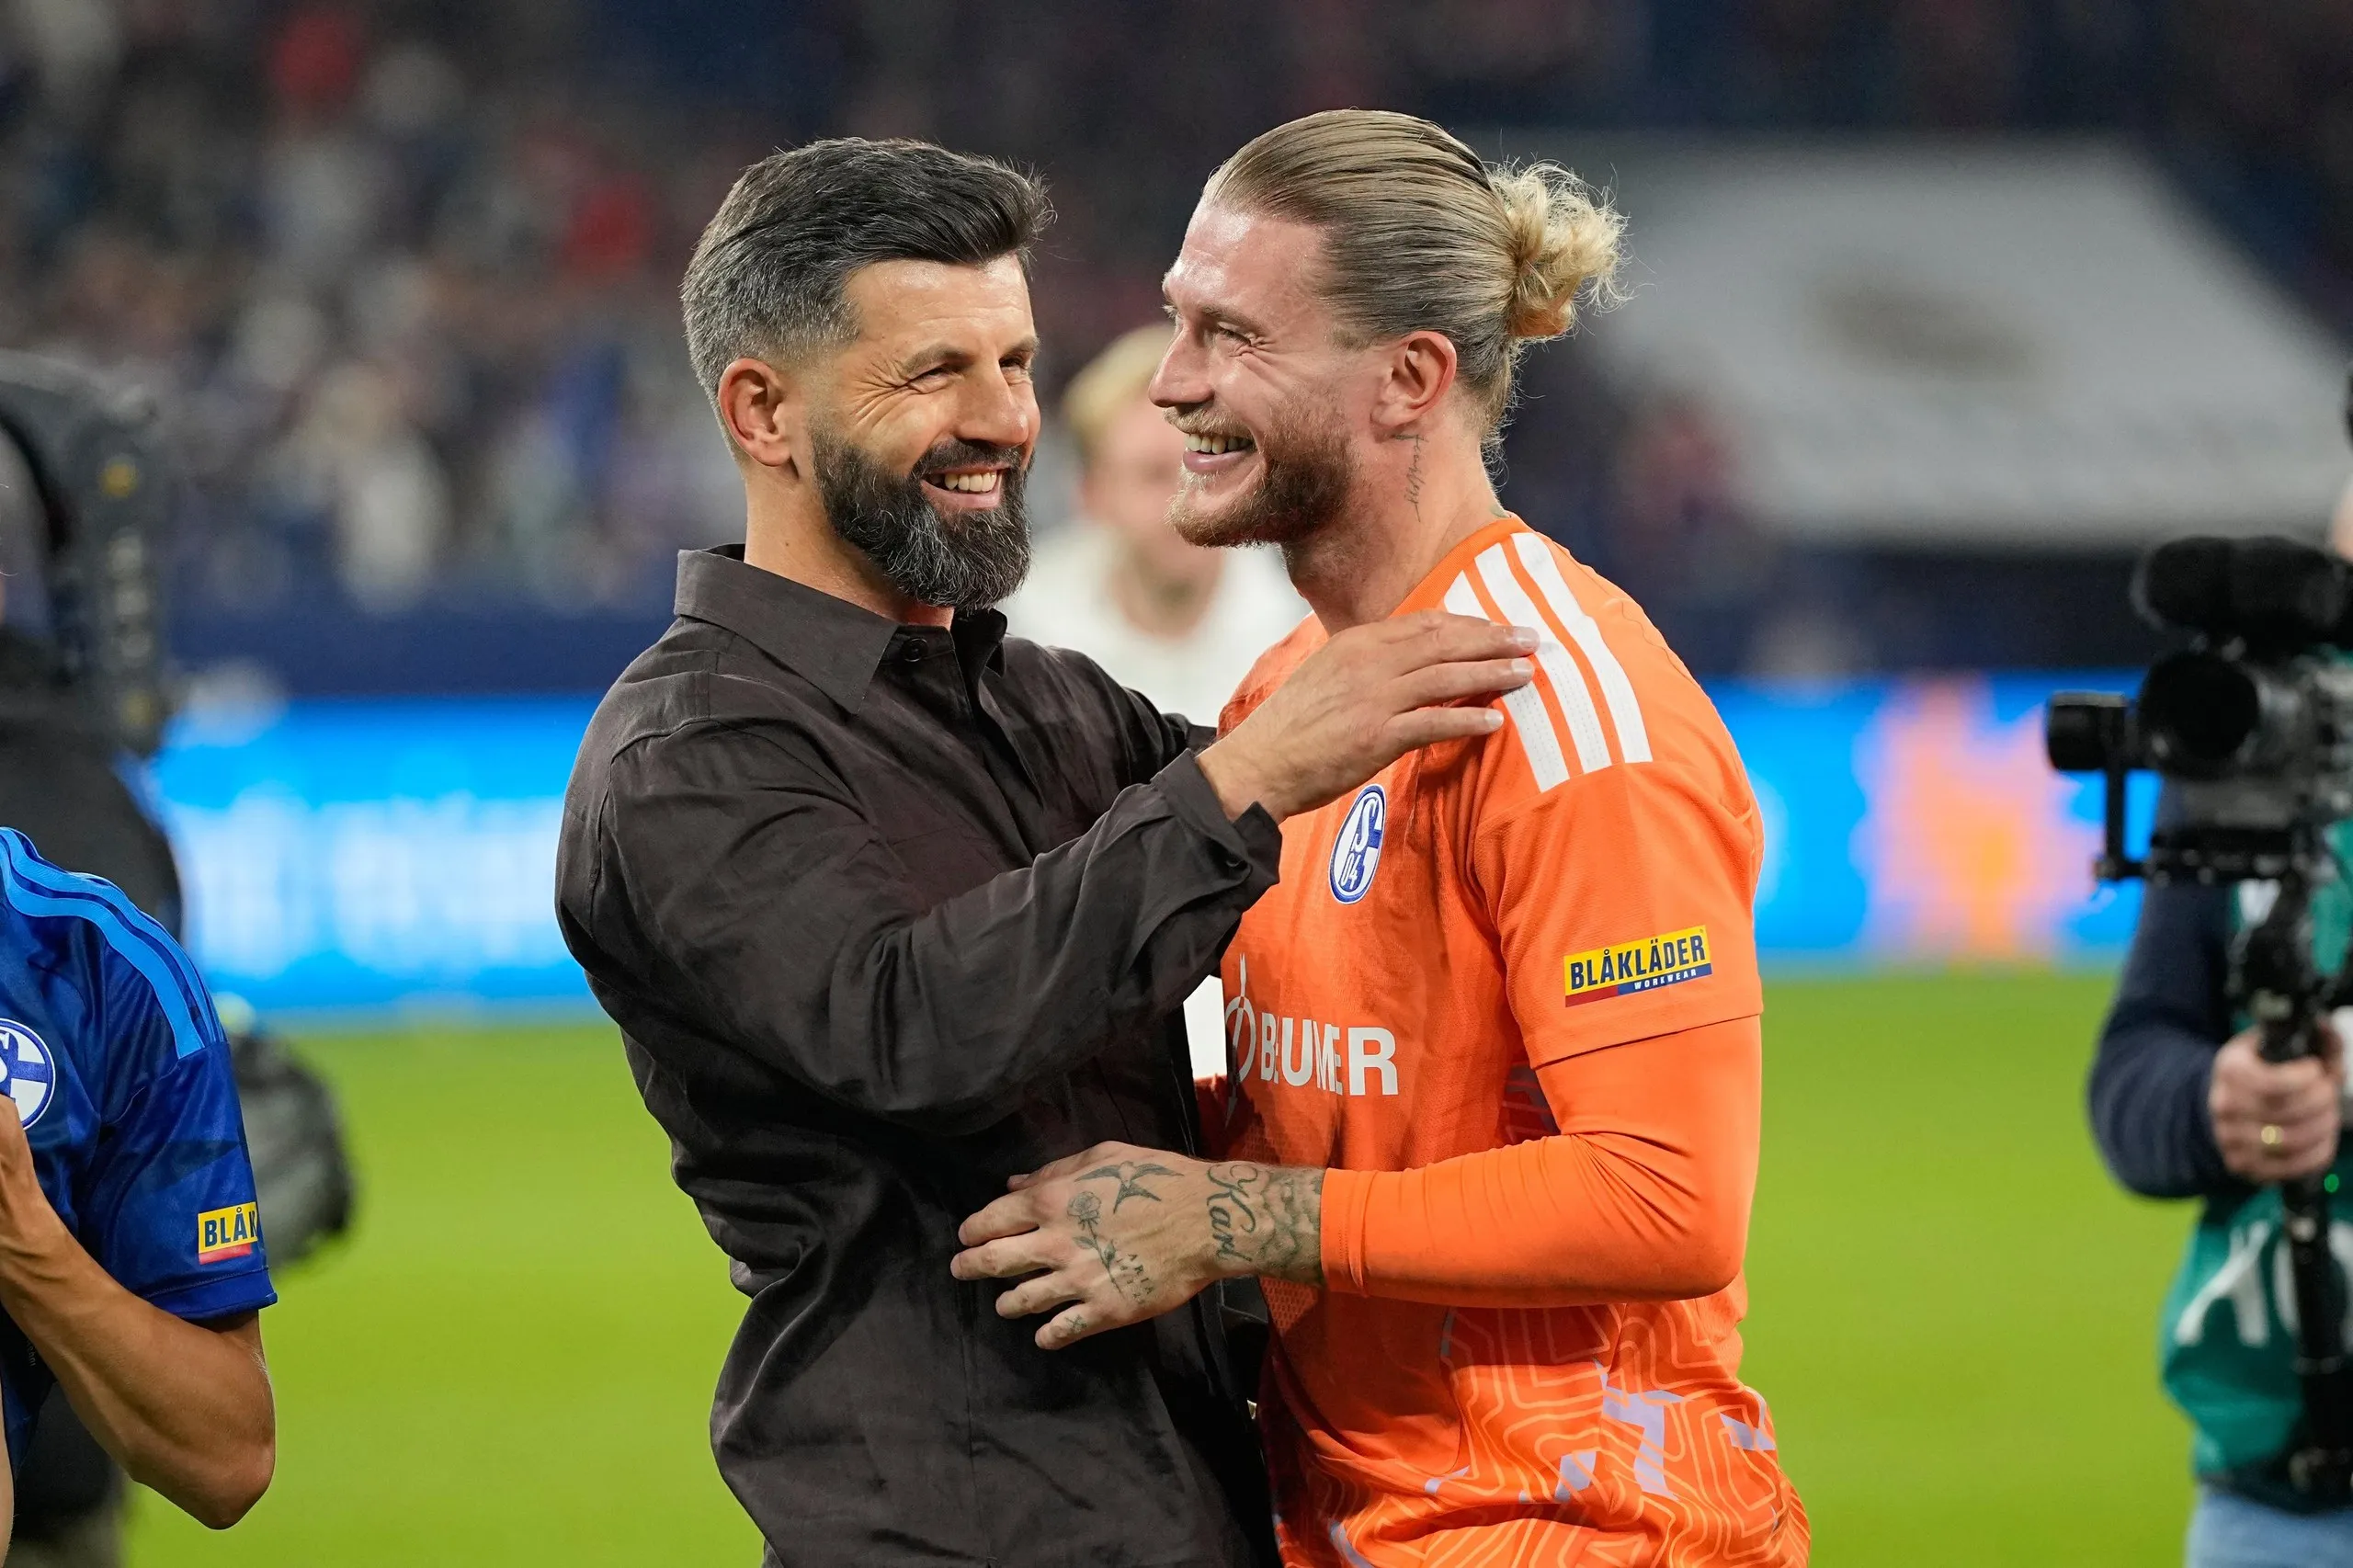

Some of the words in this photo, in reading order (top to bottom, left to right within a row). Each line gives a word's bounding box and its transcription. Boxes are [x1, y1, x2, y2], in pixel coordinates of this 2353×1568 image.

[1340, 852, 1361, 890] 04
[1570, 934, 1706, 991] BLÅKLÄDER
[1633, 969, 1697, 990] WORKWEAR
[1206, 1163, 1258, 1263] Karl
[1127, 1253, 1154, 1295] ARIA
